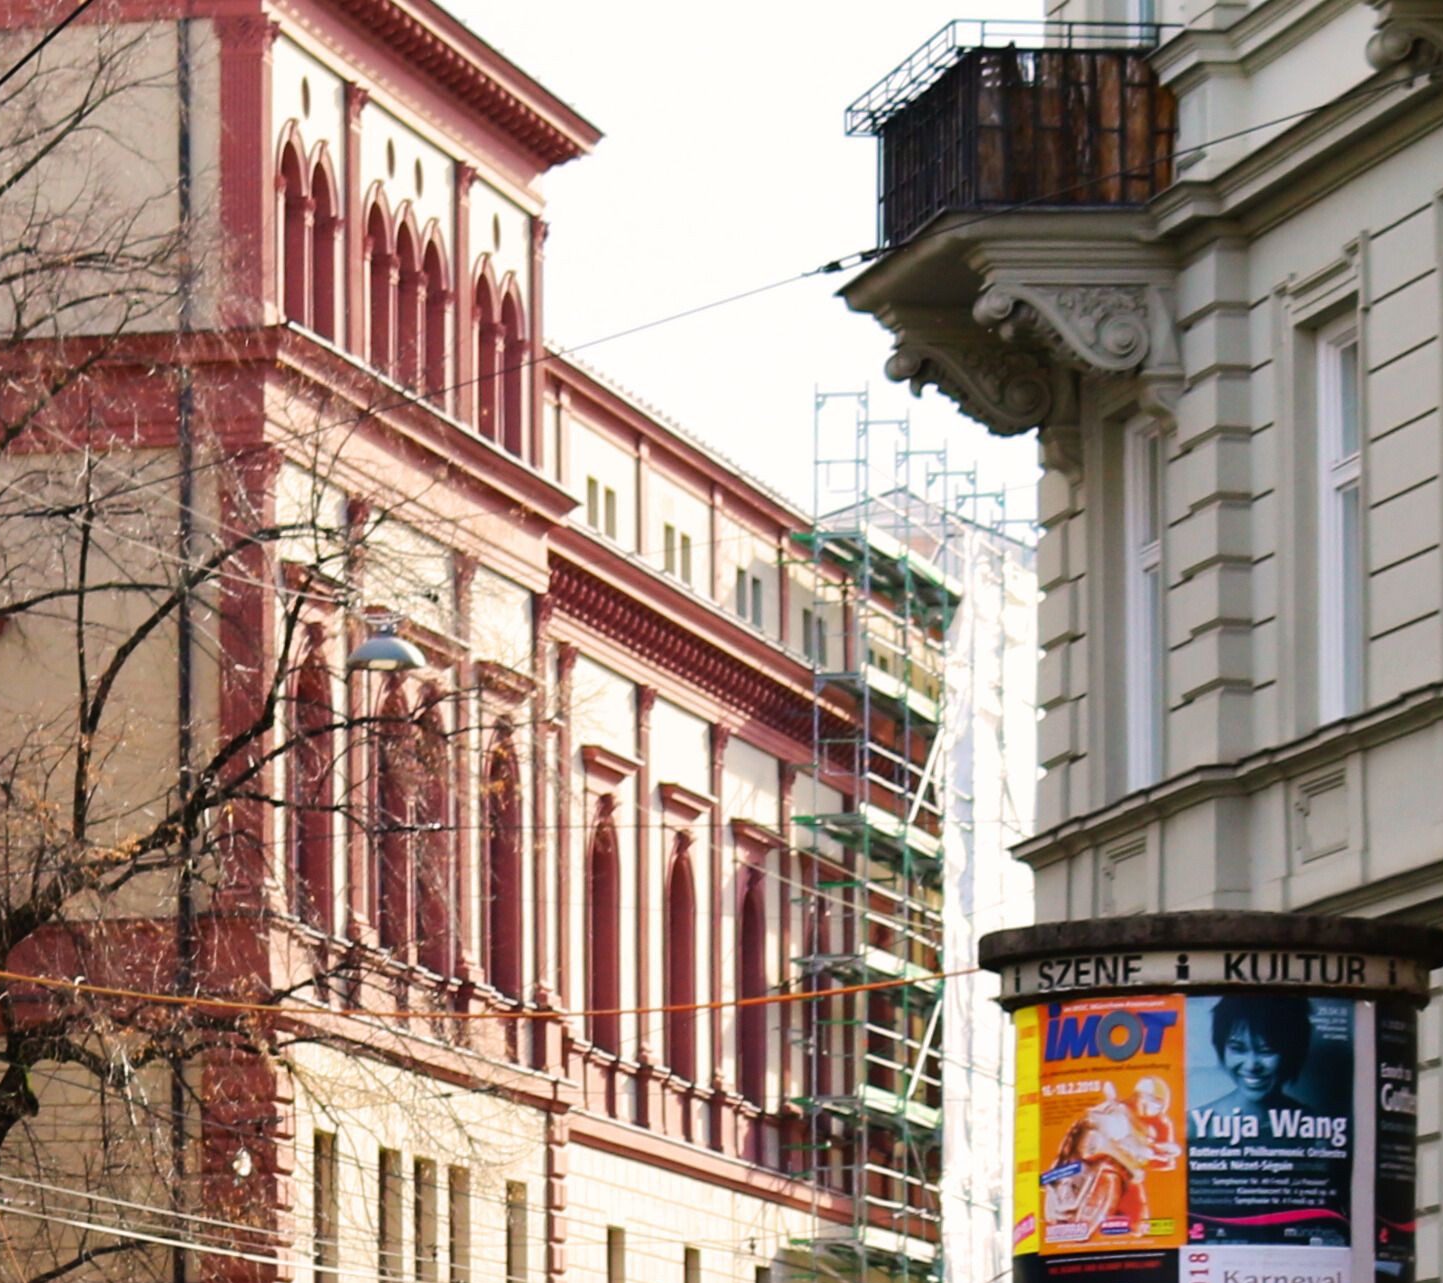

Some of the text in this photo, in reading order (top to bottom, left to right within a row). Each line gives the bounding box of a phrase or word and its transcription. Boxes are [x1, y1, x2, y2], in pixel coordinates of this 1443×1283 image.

[1224, 951, 1366, 986] KULTUR
[1191, 1107, 1348, 1147] Yuja Wang
